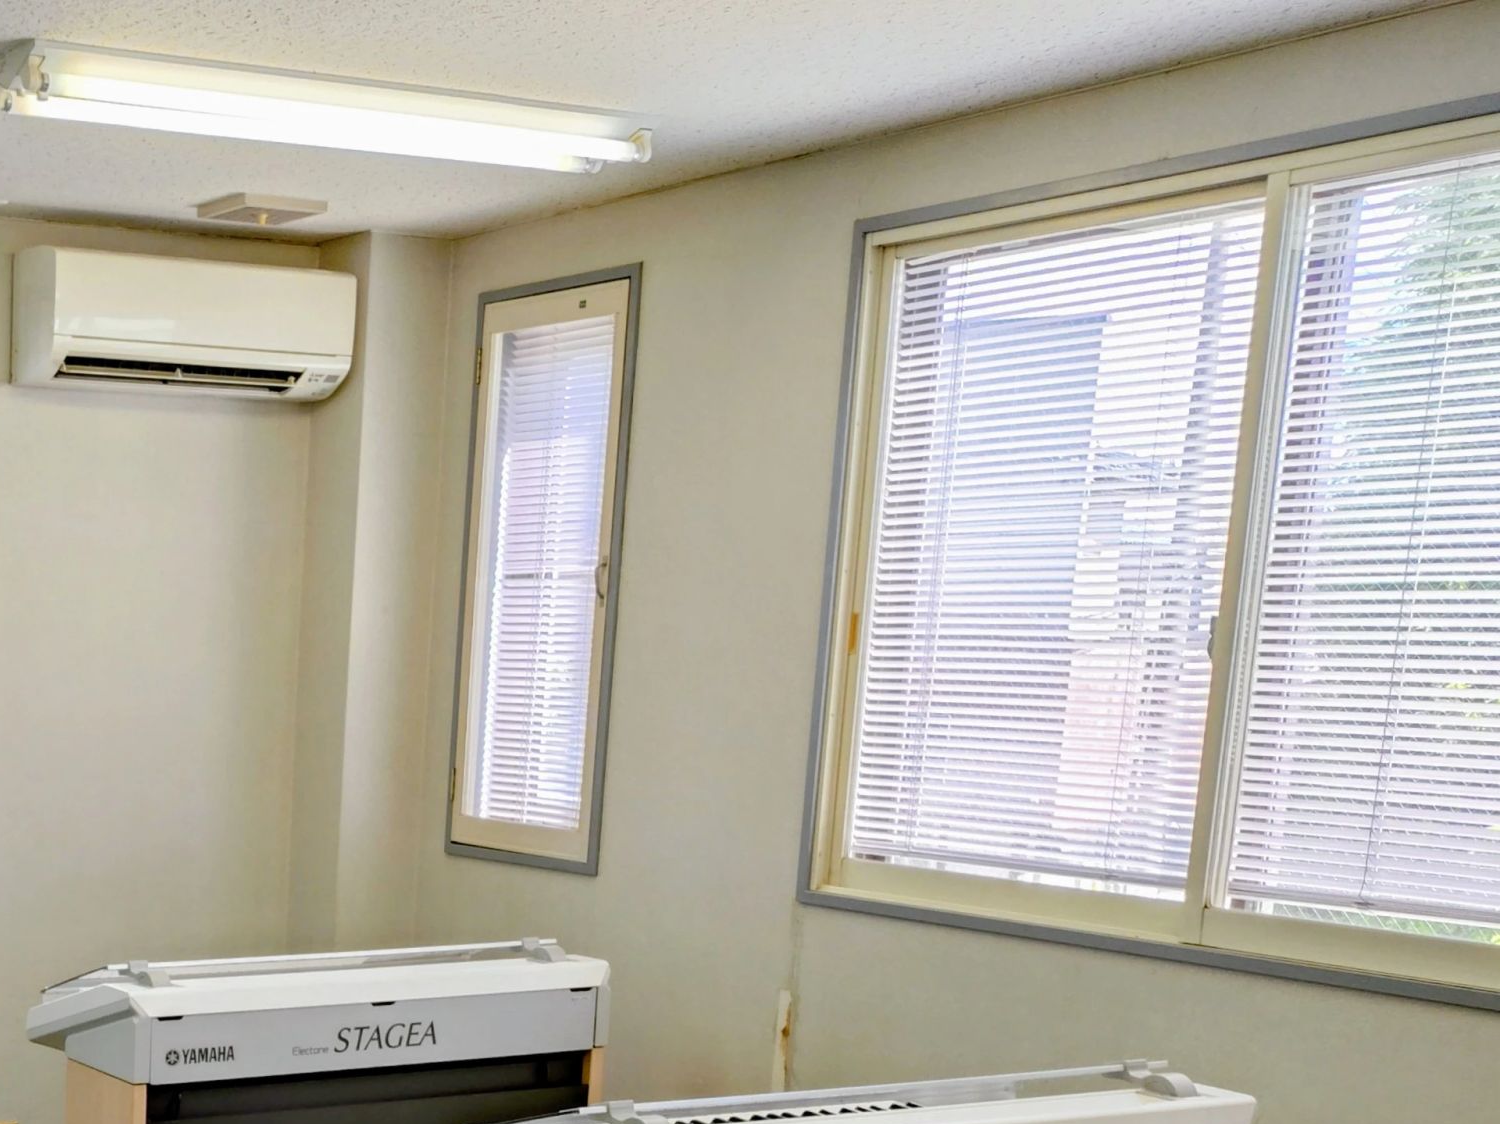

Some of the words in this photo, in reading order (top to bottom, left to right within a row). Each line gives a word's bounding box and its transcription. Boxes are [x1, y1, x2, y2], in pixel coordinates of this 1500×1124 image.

[292, 1046, 329, 1057] Electone
[334, 1021, 437, 1053] STAGEA
[182, 1045, 235, 1065] YAMAHA
